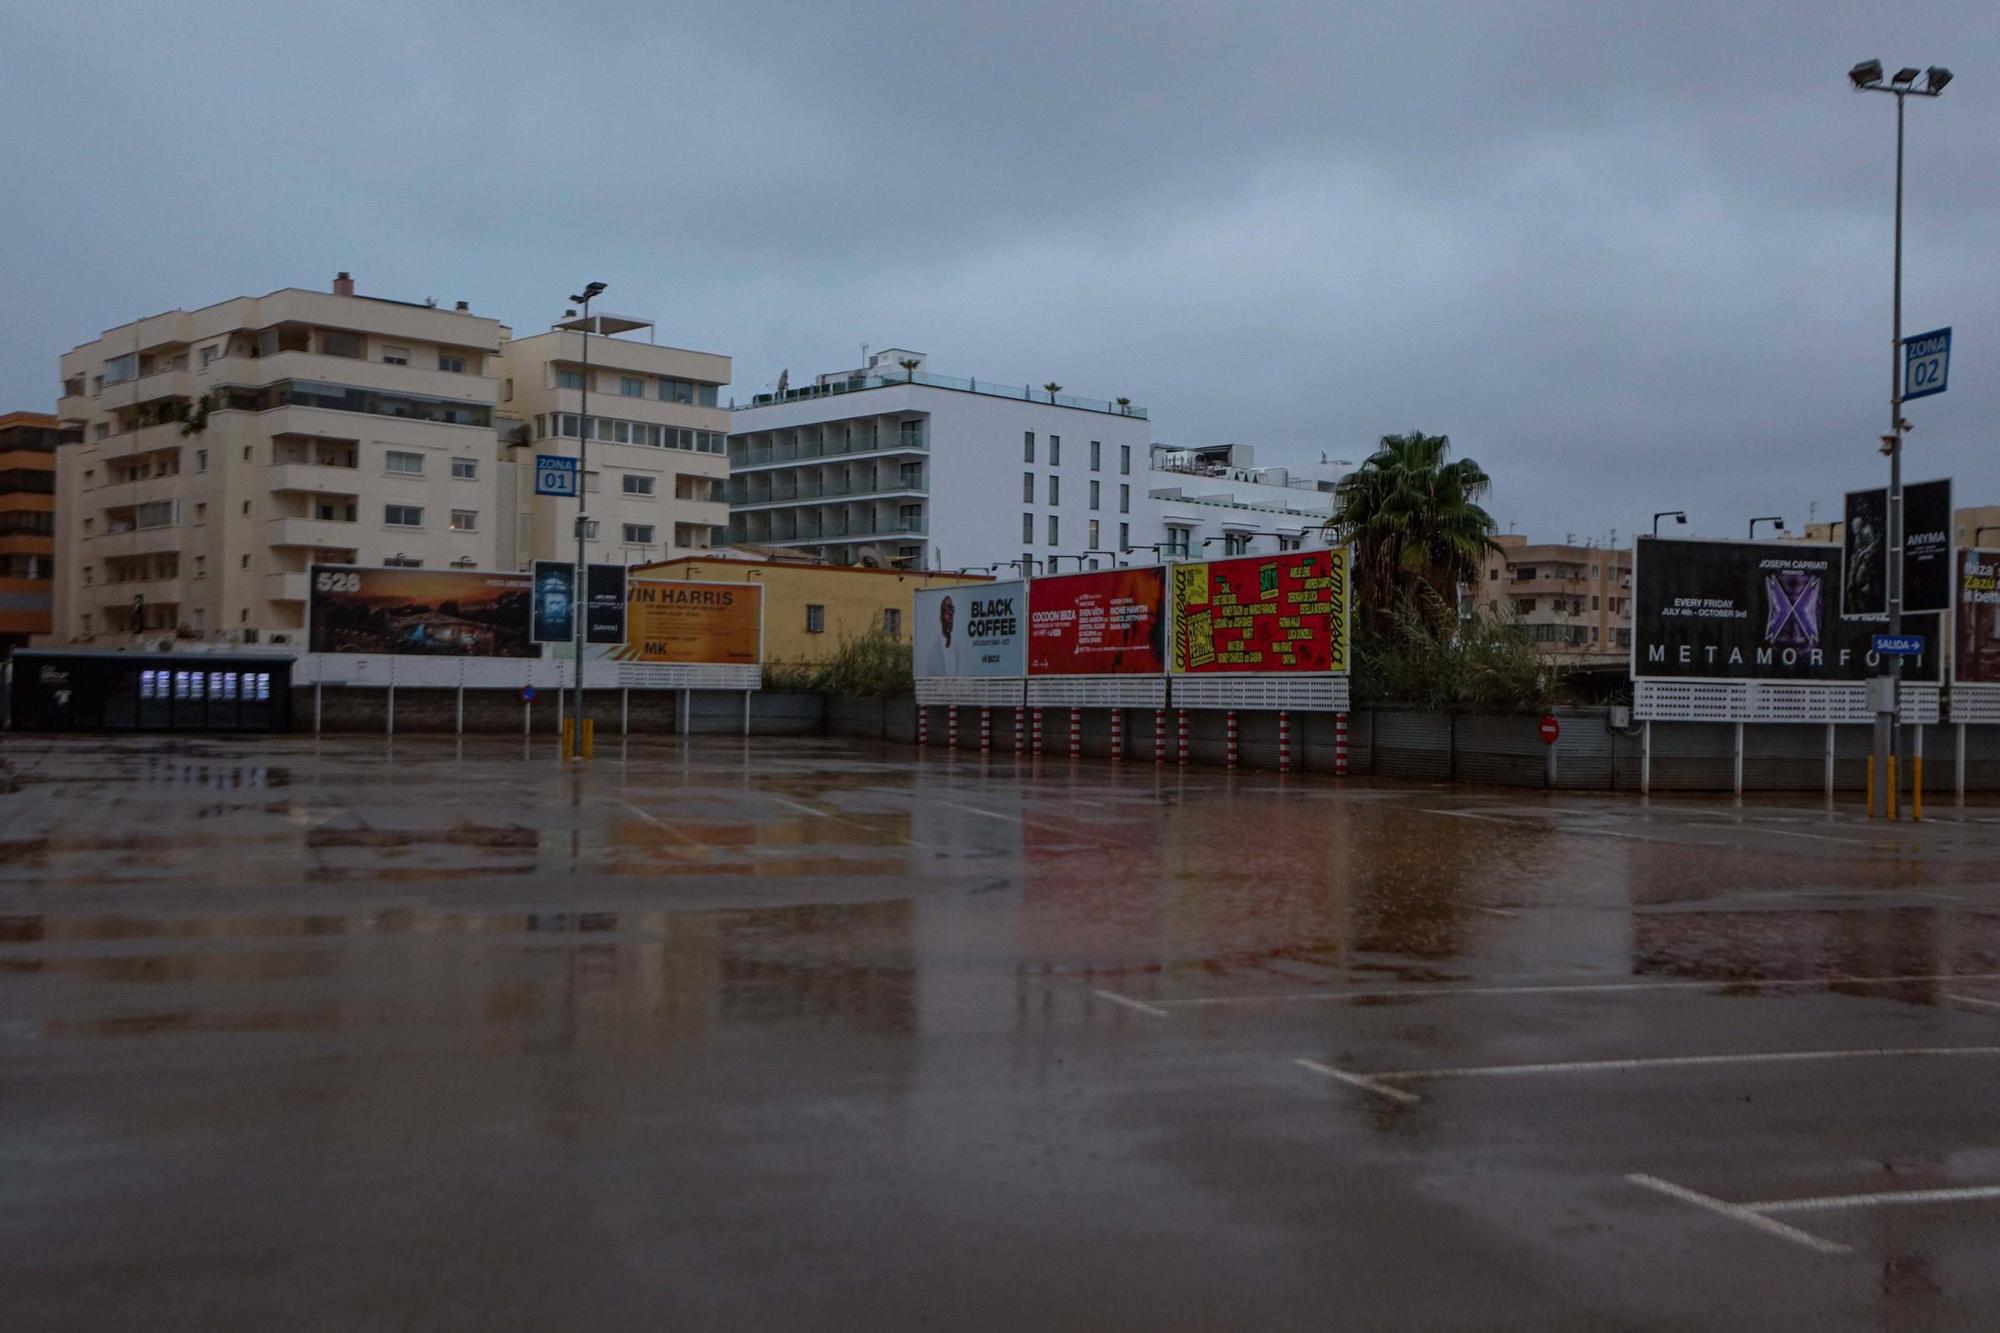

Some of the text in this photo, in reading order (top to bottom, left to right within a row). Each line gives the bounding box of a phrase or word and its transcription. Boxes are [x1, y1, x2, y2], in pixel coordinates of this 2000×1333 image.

[1909, 336, 1945, 357] ZONA
[1915, 358, 1940, 386] 02
[539, 458, 573, 470] ZONA
[545, 472, 567, 489] 01
[1907, 530, 1946, 546] ANYMA
[1760, 559, 1828, 569] JOSEPH CAPRIATI
[317, 572, 361, 592] 528
[662, 589, 734, 606] HARRIS
[1674, 598, 1734, 608] EVERY FRIDAY
[971, 598, 1014, 618] BLACK
[1033, 611, 1059, 622] COCOON
[1060, 610, 1076, 621] IBIZA
[1331, 554, 1343, 665] amnesia
[1662, 607, 1680, 616] JULY
[1698, 608, 1733, 617] OCTOBER
[1175, 569, 1186, 668] amnesia
[968, 618, 1016, 637] COFFEE
[645, 642, 668, 655] MK
[1876, 639, 1911, 650] SALIDA
[1649, 644, 1922, 668] METAMORFOI
